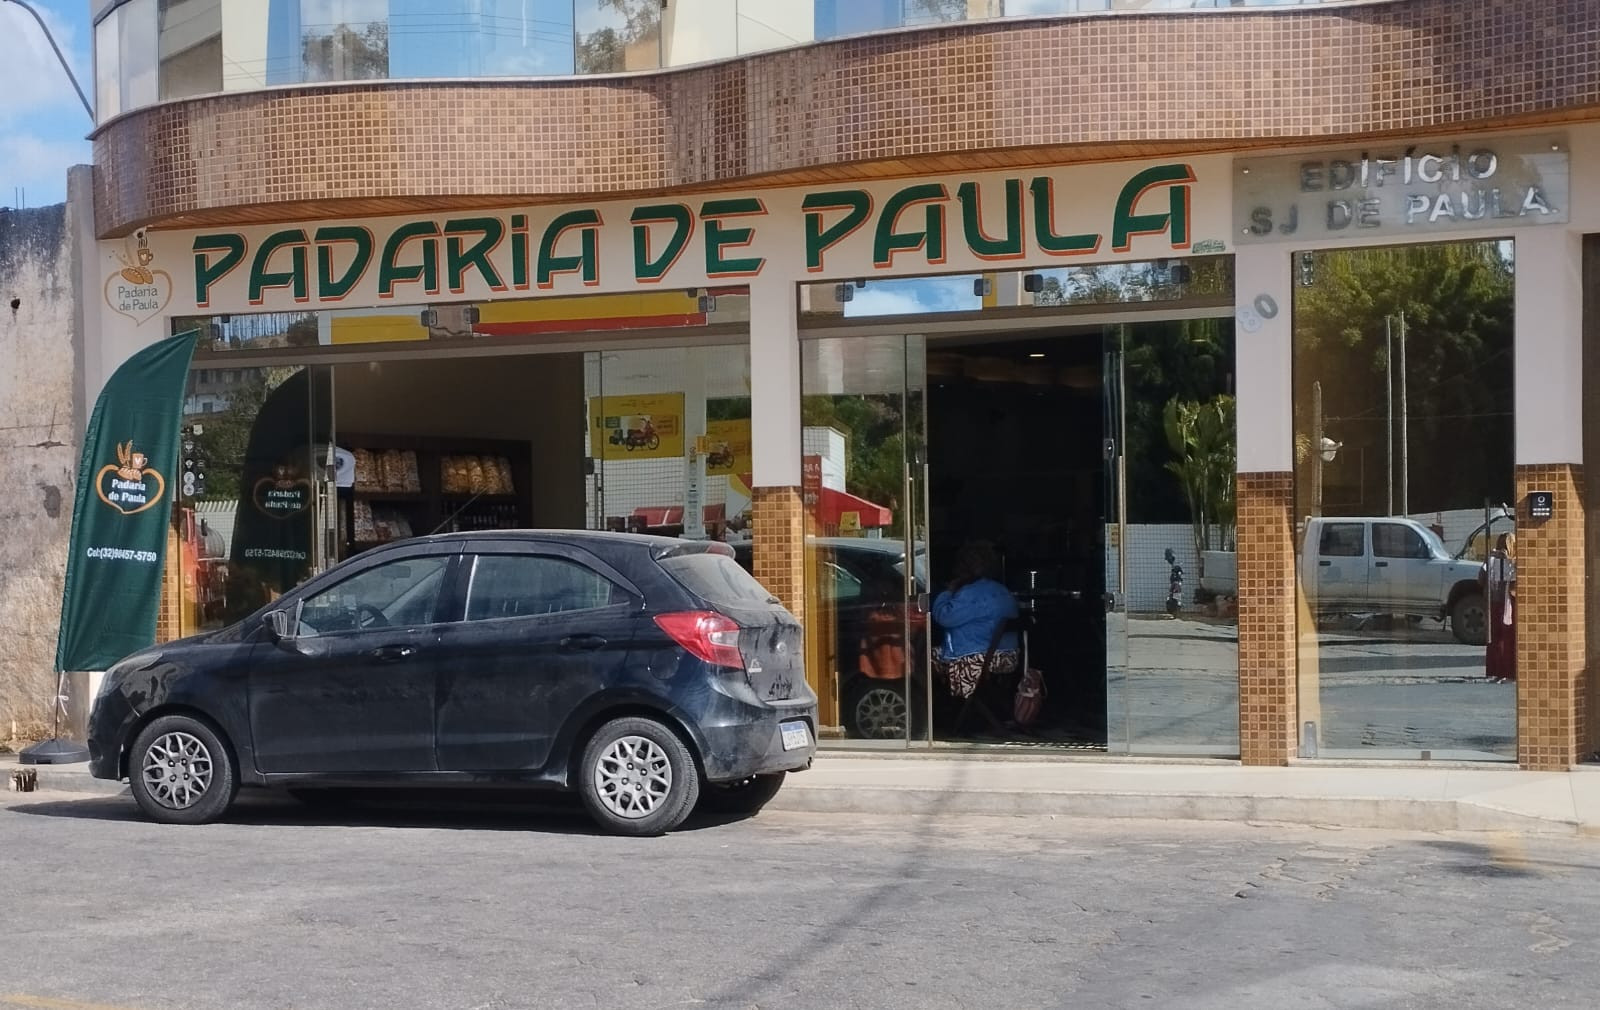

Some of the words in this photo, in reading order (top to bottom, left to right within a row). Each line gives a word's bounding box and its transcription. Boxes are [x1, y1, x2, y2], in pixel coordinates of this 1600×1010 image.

[1250, 202, 1299, 236] SJ
[1327, 197, 1382, 231] DE
[1404, 186, 1550, 225] PAULA
[630, 197, 768, 284] DE
[801, 163, 1197, 273] PAULA
[118, 286, 158, 299] Padaria
[119, 300, 131, 311] de
[132, 299, 159, 310] Paula
[112, 479, 146, 490] Padaria
[108, 491, 120, 501] de
[122, 492, 146, 503] Paula
